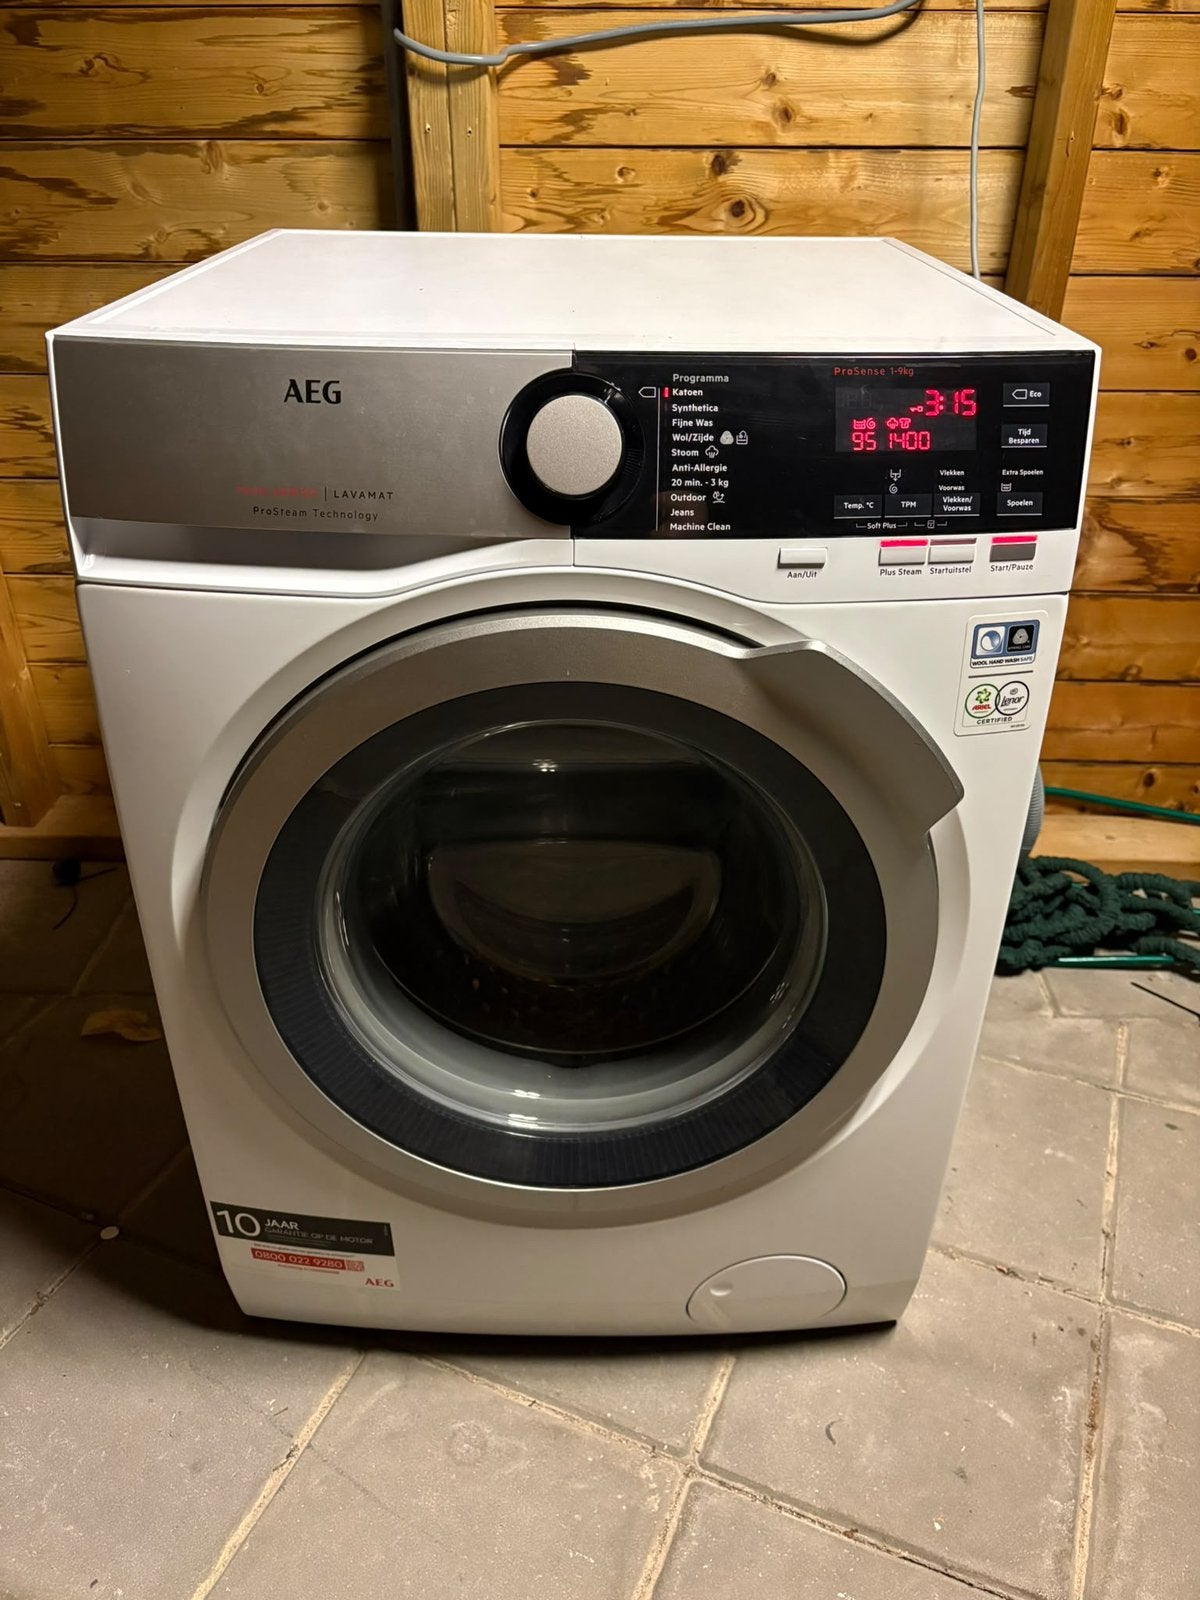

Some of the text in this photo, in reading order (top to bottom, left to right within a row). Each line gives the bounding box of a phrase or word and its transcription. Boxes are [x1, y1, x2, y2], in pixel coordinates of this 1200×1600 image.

[834, 366, 914, 377] ProSense 1-9kg
[672, 373, 729, 384] Programma
[283, 379, 342, 405] AEG
[672, 388, 703, 396] Katoen
[925, 389, 977, 416] 3:15
[671, 403, 719, 413] Synthetica
[671, 418, 713, 428] Fijne Was
[1018, 428, 1031, 436] Tijd
[672, 433, 714, 443] Wol/Zijde
[852, 431, 930, 450] 95 1400
[671, 448, 699, 457] Stoom
[672, 464, 728, 473] Anti-Allergie
[1020, 468, 1044, 476] Spoelen
[684, 478, 703, 486] min.
[718, 478, 729, 488] kg
[333, 489, 394, 500] LAVAMAT
[670, 494, 706, 502] Outdoor
[1006, 499, 1034, 507] Spoelen
[253, 506, 378, 522] ProSteam Technology
[670, 508, 695, 516] Jeans
[670, 523, 731, 531] Machine Clean
[880, 568, 922, 576] Plus Steam
[930, 566, 972, 574] Startuitstel
[990, 562, 1034, 572] Start/Pauze
[976, 716, 1013, 725] CERTIFIED
[216, 1210, 261, 1237] 10
[264, 1218, 300, 1231] JAAR
[264, 1226, 308, 1239] GARANTIE
[340, 1236, 374, 1244] MOTOR
[254, 1250, 286, 1262] 0800
[288, 1254, 310, 1265] 022
[313, 1258, 342, 1269] 9280
[365, 1278, 394, 1288] AEG
